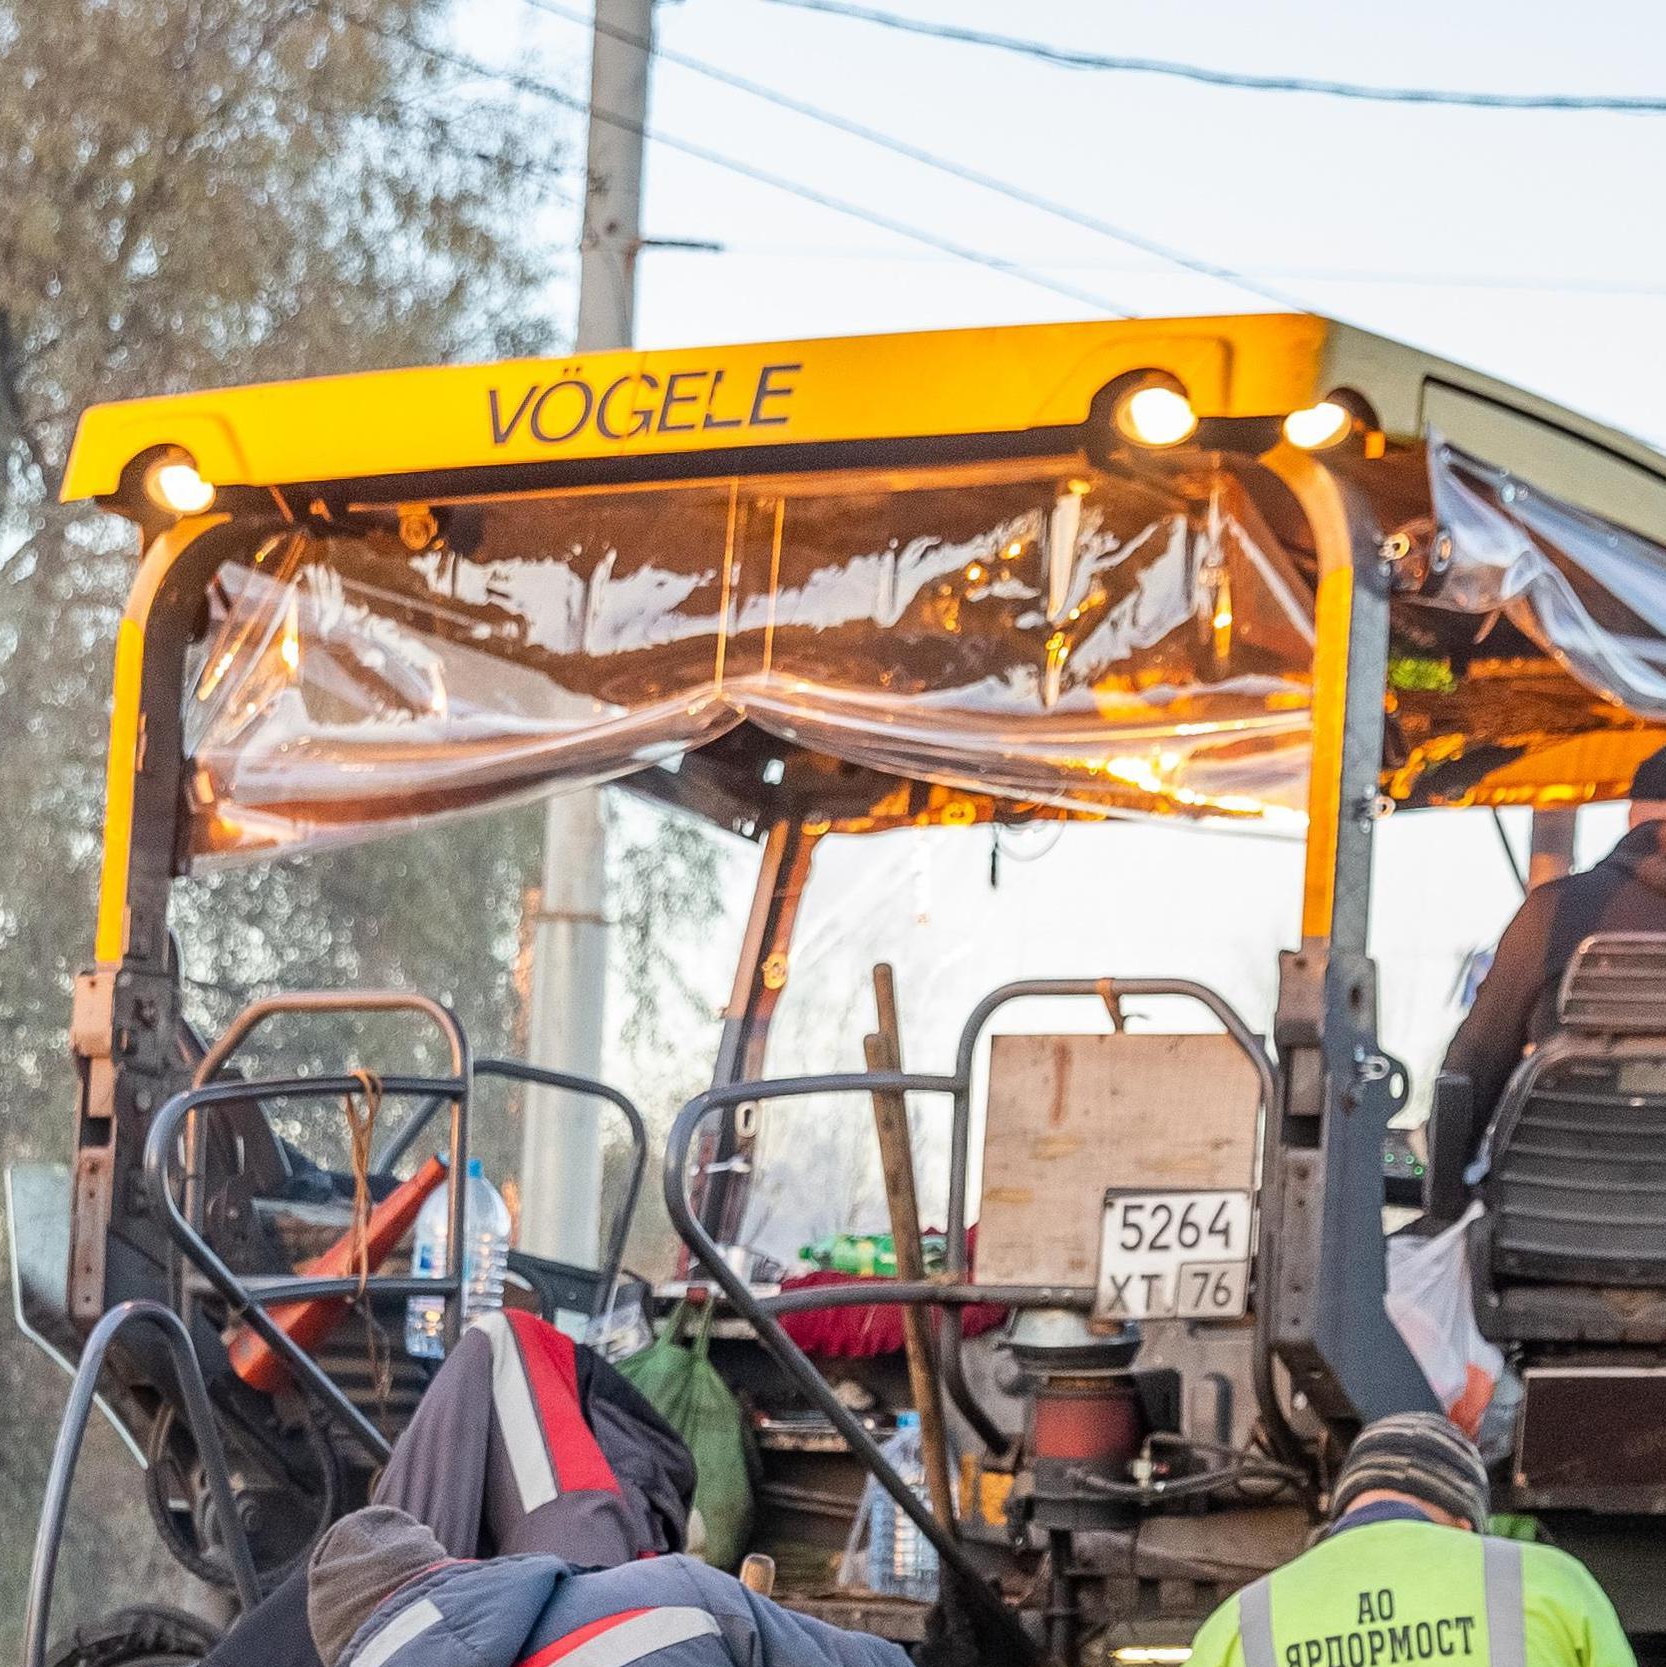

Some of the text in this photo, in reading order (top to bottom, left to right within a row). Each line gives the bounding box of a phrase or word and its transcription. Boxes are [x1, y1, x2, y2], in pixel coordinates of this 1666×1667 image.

[488, 363, 802, 446] VÖGELE
[1120, 1200, 1231, 1251] 5264
[1192, 1272, 1231, 1307] 76
[1357, 1589, 1395, 1625] АО
